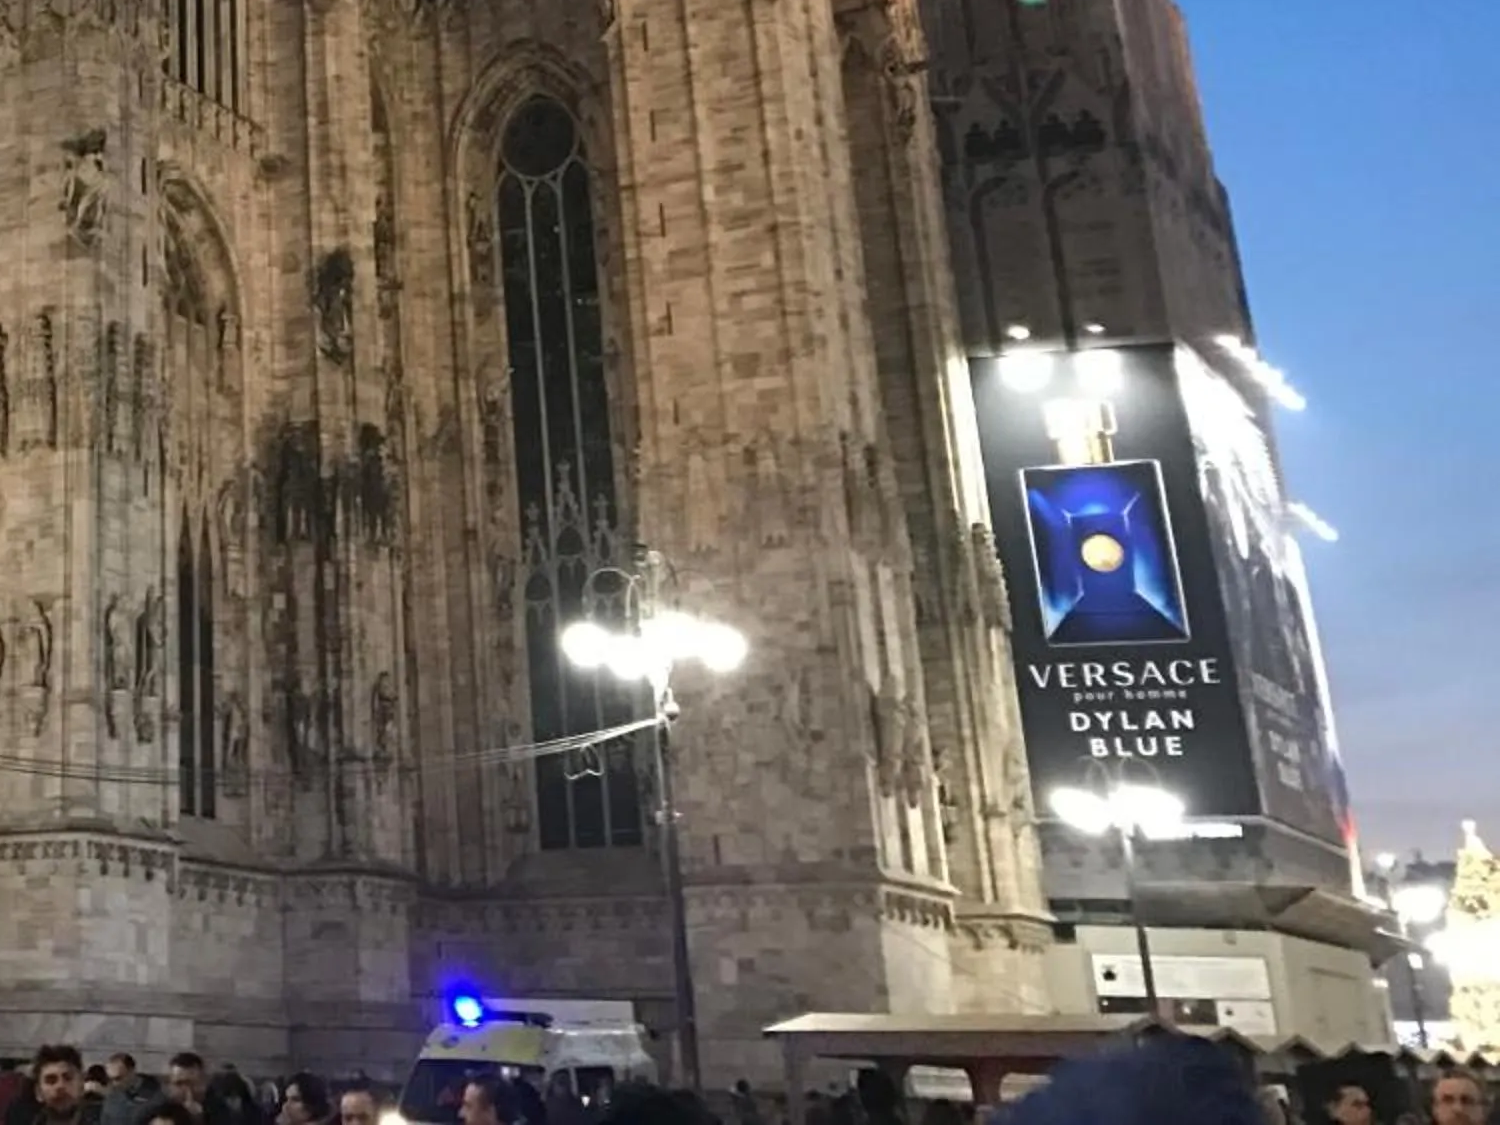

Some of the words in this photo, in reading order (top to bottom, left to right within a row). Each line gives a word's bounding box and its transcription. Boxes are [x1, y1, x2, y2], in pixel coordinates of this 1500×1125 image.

[1028, 658, 1221, 689] VERSACE
[1072, 691, 1115, 704] pour
[1124, 689, 1188, 701] homme
[1068, 708, 1195, 732] DYLAN
[1088, 735, 1184, 758] BLUE
